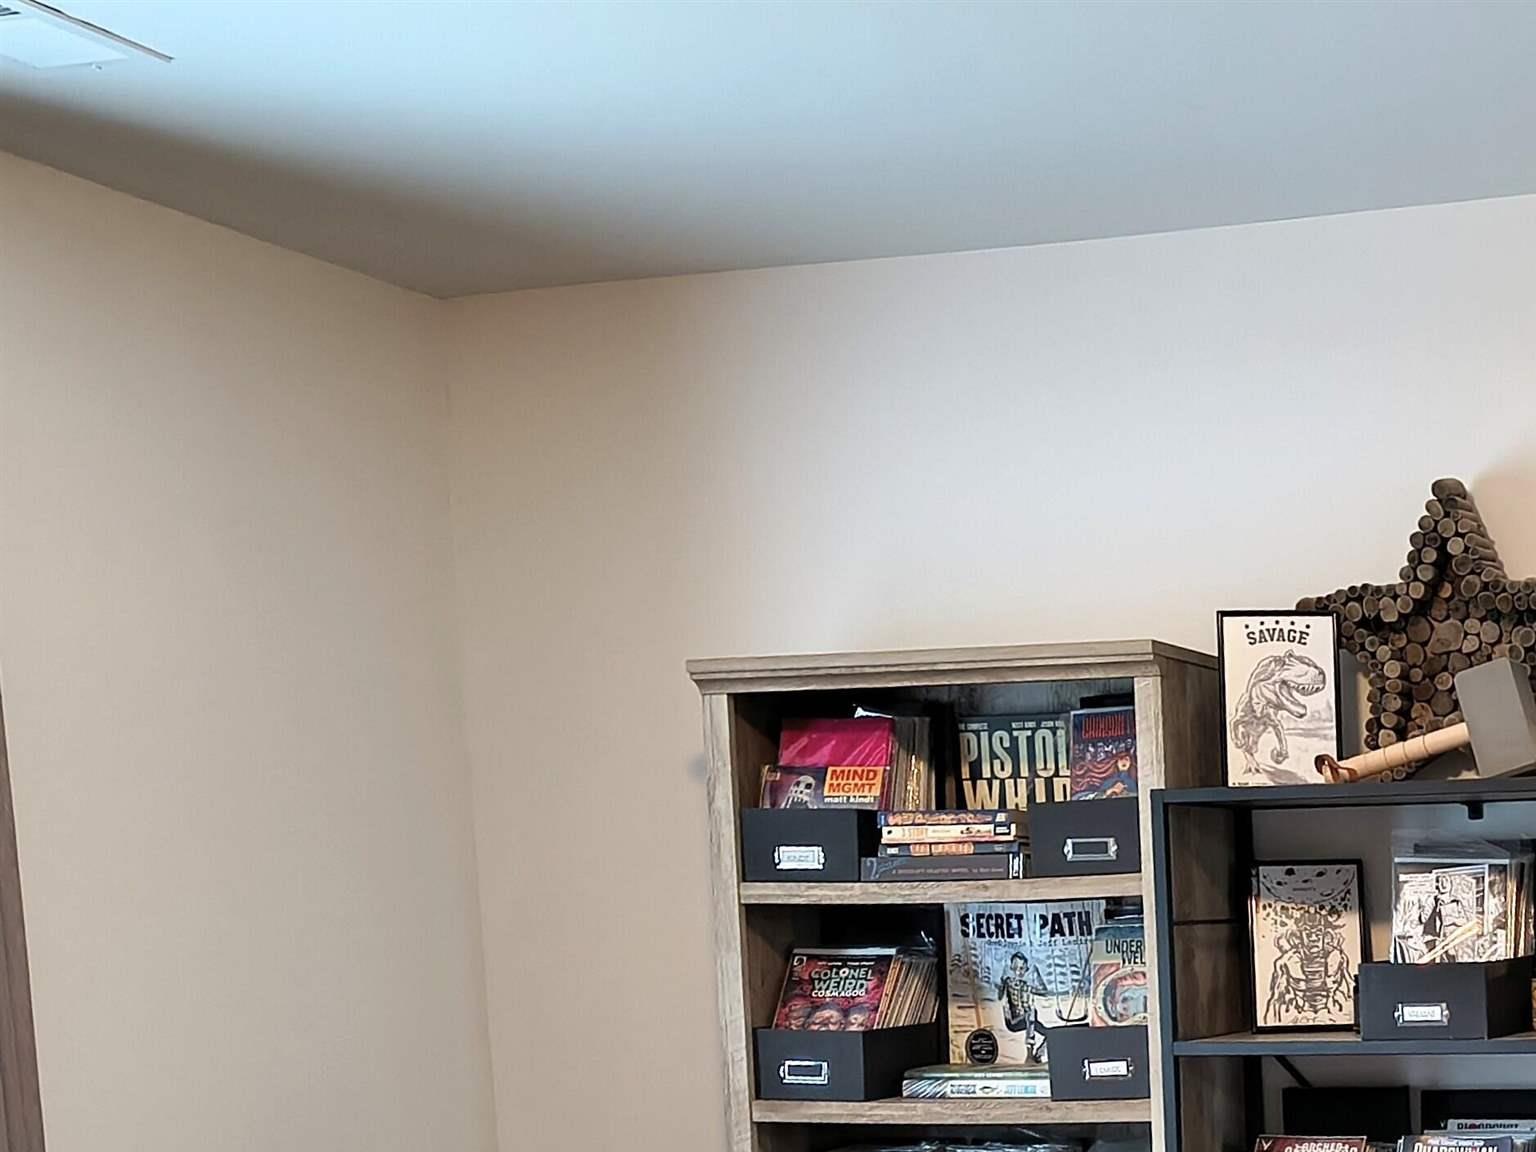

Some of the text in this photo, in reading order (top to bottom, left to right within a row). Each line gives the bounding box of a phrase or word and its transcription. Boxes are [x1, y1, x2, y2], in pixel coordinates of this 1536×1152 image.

[1246, 627, 1310, 646] SAVAGE
[959, 729, 1071, 779] PISTOL
[829, 768, 877, 782] MIND
[827, 782, 877, 794] MGMT
[959, 910, 1093, 939] SECRET PATH
[810, 967, 874, 980] COLONEL
[814, 979, 868, 992] WEIRD
[811, 989, 866, 998] COSMAGOG
